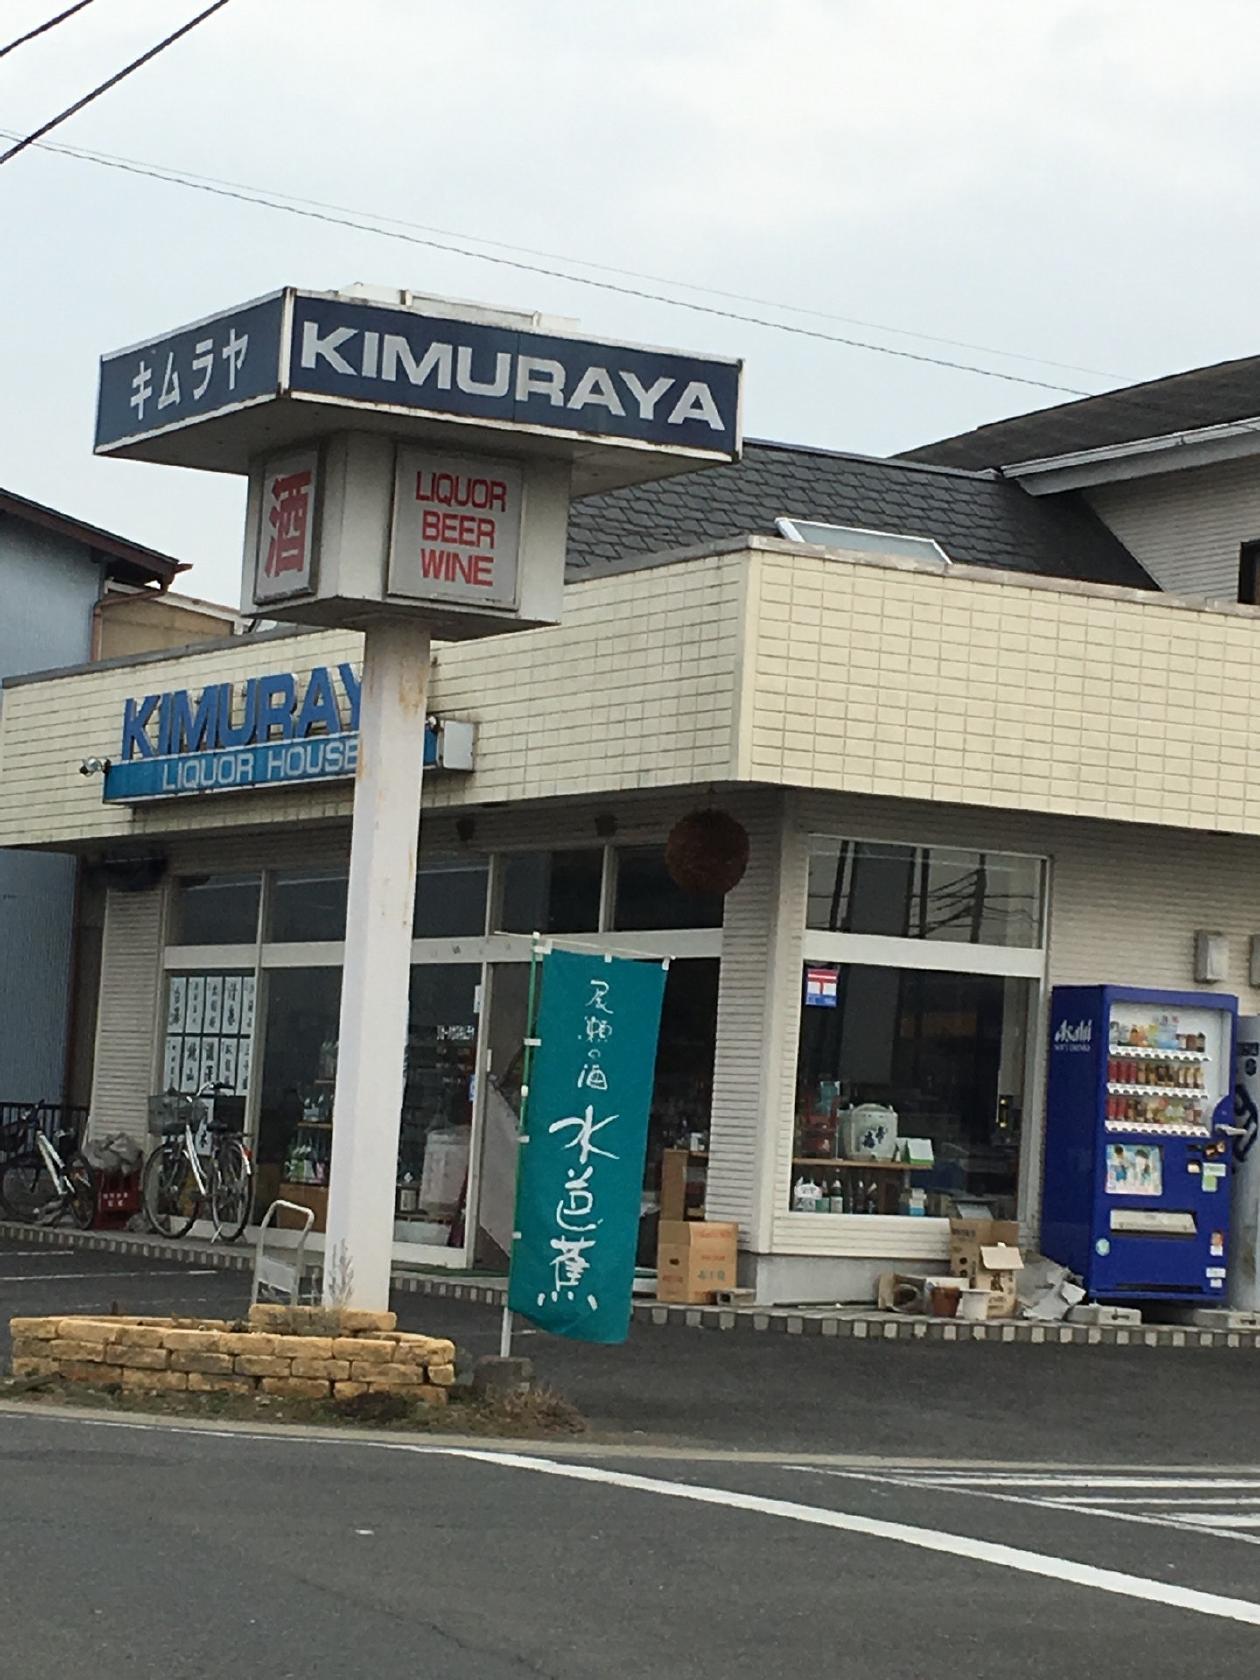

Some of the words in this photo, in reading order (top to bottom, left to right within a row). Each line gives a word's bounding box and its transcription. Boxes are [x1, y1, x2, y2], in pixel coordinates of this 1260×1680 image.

[130, 328, 249, 420] キムラヤ
[300, 321, 726, 431] KIMURAYA
[264, 470, 312, 578] 酒
[415, 471, 507, 513] LIQUOR
[422, 509, 496, 550] BEER
[420, 547, 495, 587] WINE
[121, 662, 363, 760] KIMURAY
[162, 752, 254, 791] LIQUOR
[267, 741, 358, 780] HOUSE
